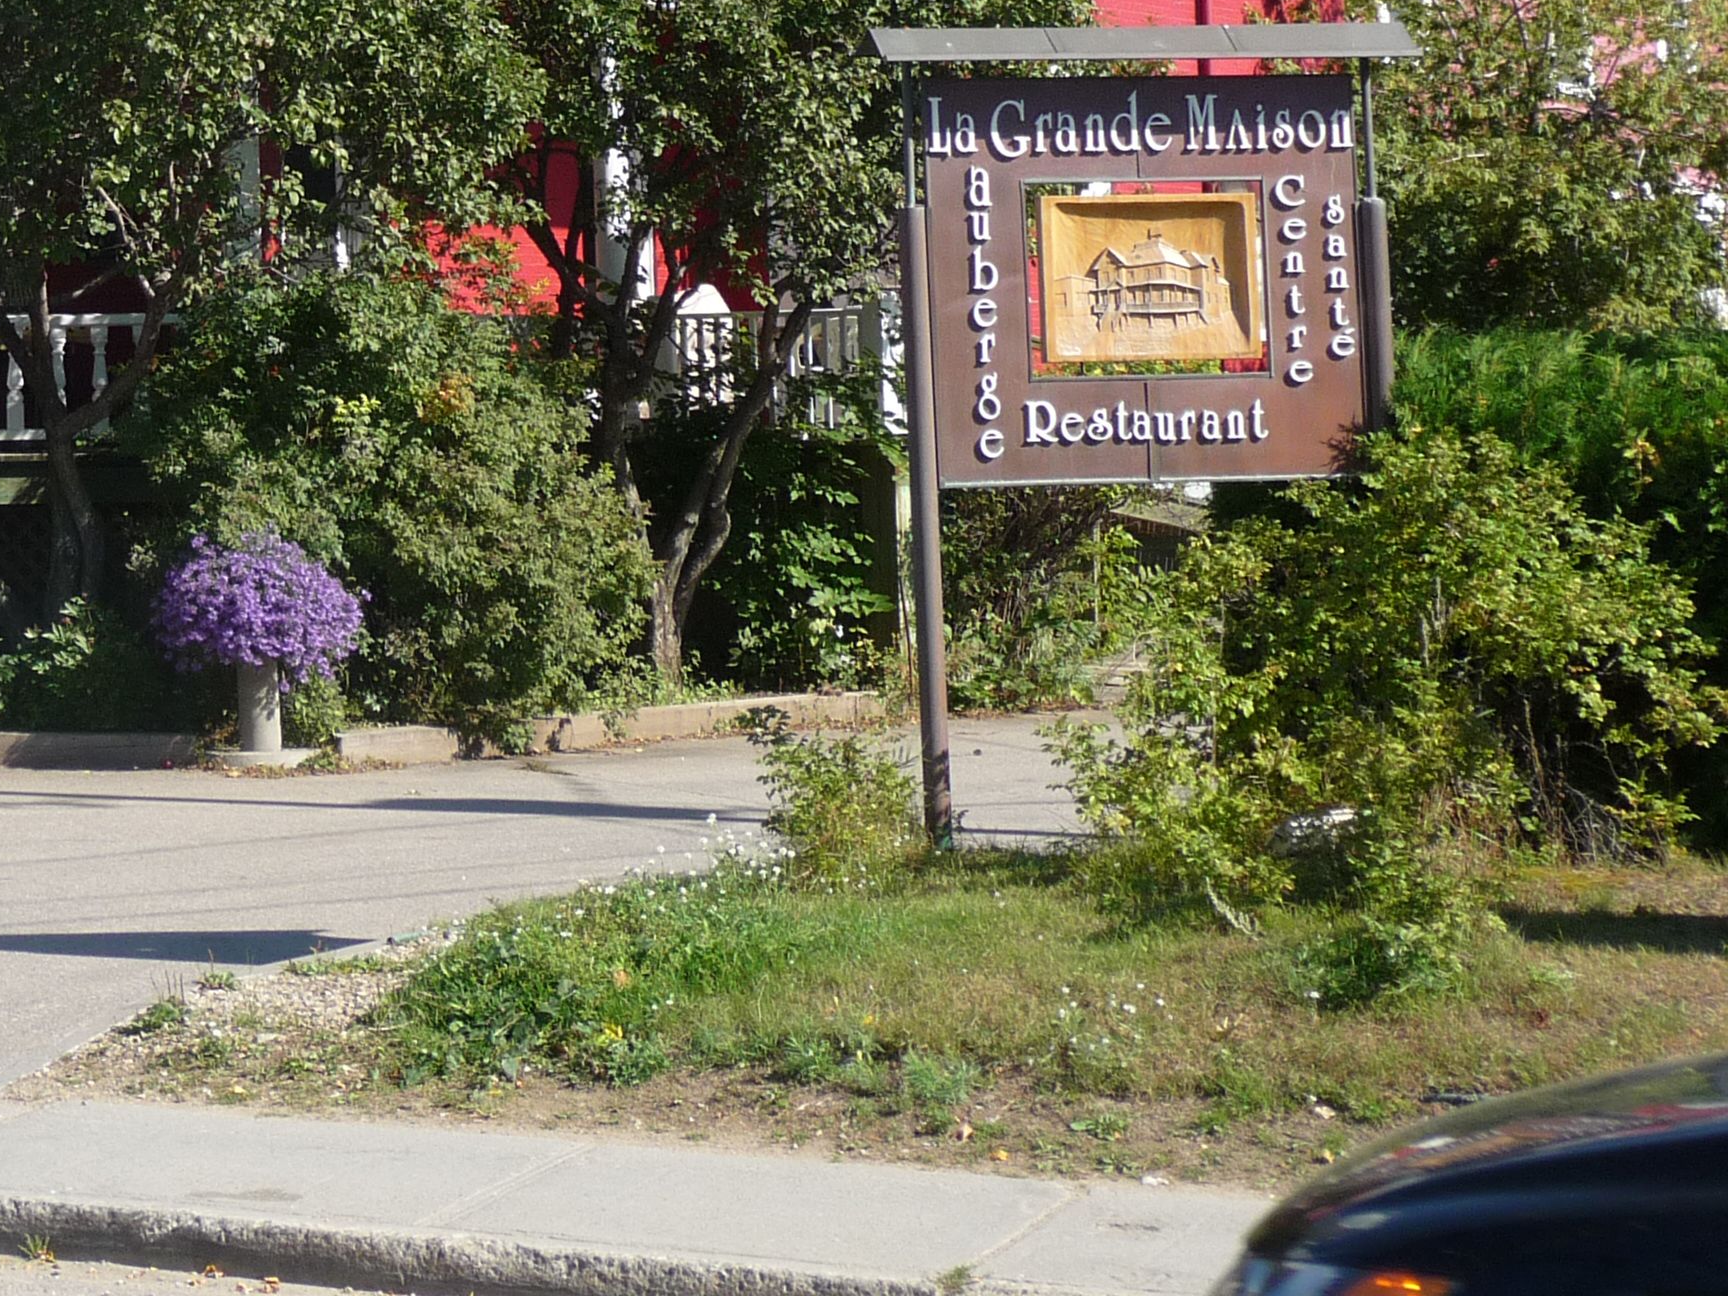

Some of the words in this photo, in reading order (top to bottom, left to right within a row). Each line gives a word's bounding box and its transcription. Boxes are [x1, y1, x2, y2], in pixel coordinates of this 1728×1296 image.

[927, 97, 976, 156] La
[990, 91, 1173, 158] Grande
[1274, 175, 1314, 384] Centre
[1325, 194, 1355, 358] santé
[1024, 399, 1268, 444] Restaurant
